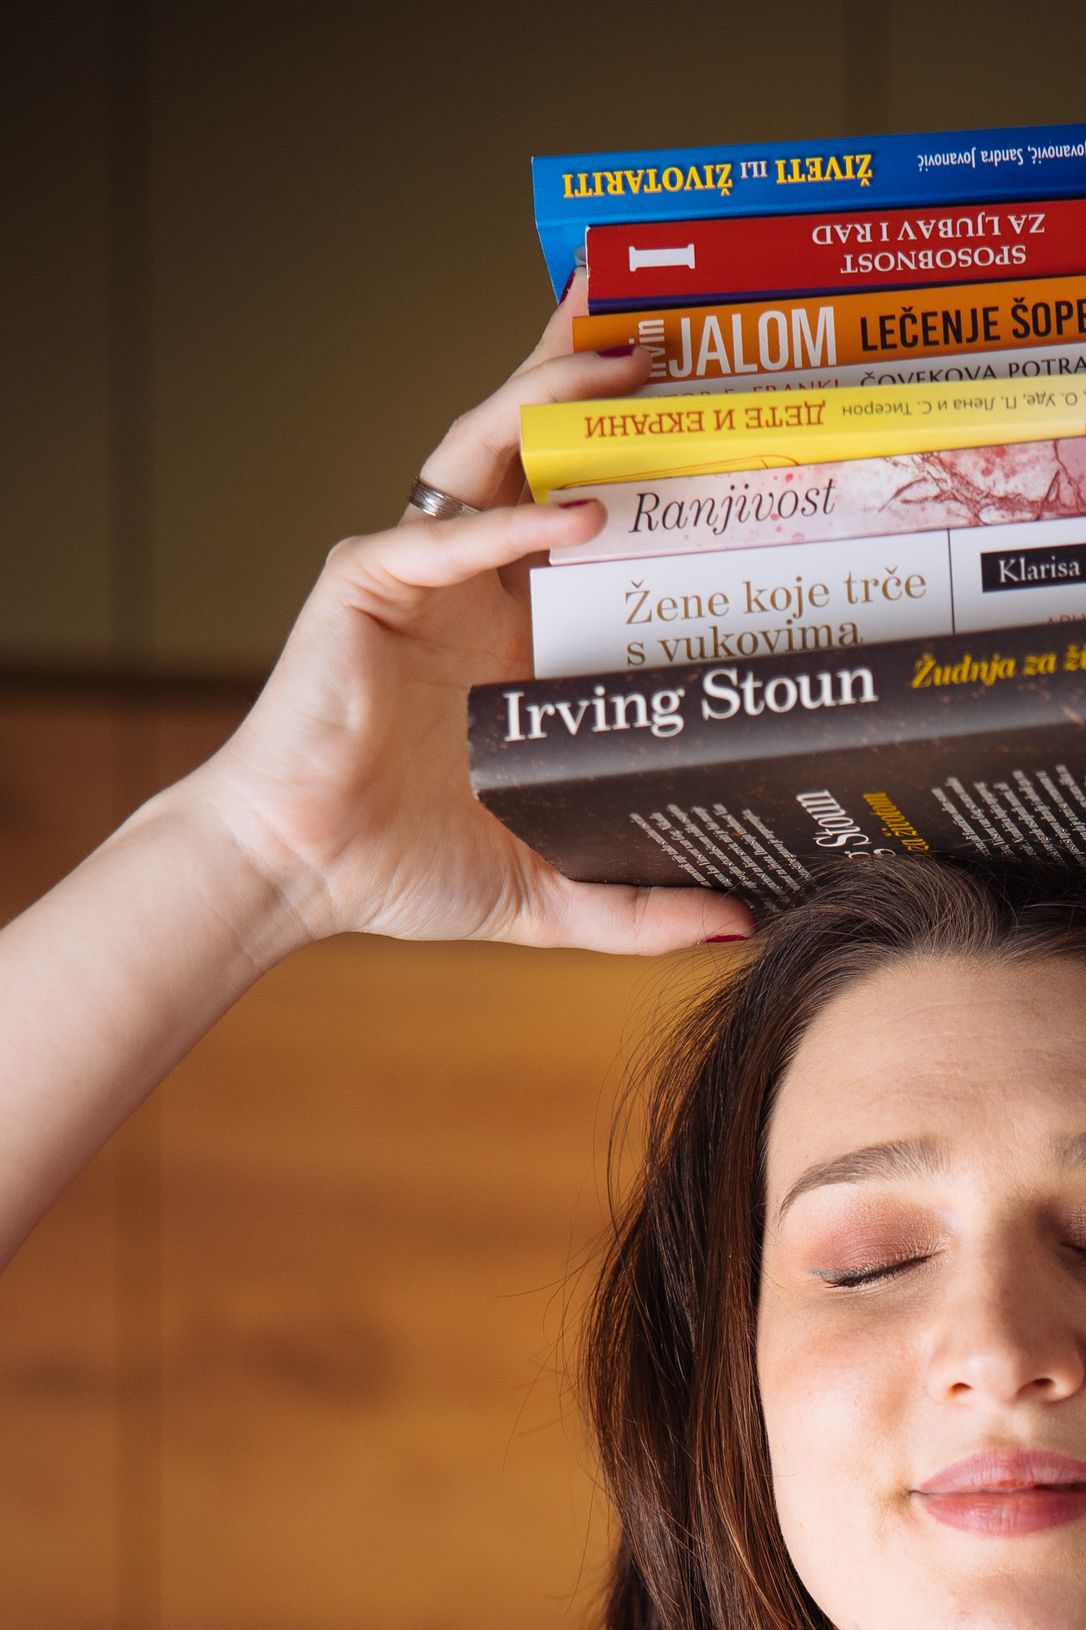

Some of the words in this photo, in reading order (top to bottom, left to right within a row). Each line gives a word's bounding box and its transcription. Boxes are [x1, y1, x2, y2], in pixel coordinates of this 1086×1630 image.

[741, 160, 767, 179] ILI
[776, 154, 872, 187] ŽIVETI
[918, 147, 976, 172] Jovanović
[981, 148, 1024, 167] Sandra
[562, 163, 732, 198] ŽIVOTARITI
[811, 223, 873, 245] RAD
[880, 222, 890, 242] I
[897, 212, 1001, 240] LJUBAV
[1008, 213, 1046, 235] ZA
[840, 245, 1026, 274] SPOSOBNOST
[859, 304, 1000, 352] LEČENJE
[669, 306, 838, 379] JALOM
[842, 401, 912, 416] Тисерон
[917, 401, 932, 413] С.
[937, 400, 948, 411] и
[953, 397, 996, 411] Лена
[1000, 397, 1017, 410] П.
[1022, 392, 1056, 408] Уде,
[1061, 392, 1078, 407] О.
[585, 411, 705, 439] ЕКРАНИ
[714, 409, 735, 431] И
[746, 399, 826, 429] ДЕТЕ
[627, 478, 837, 536] Ranjivost
[997, 556, 1081, 583] Klarisa
[624, 579, 730, 626] Žene
[743, 579, 830, 620] koje
[844, 565, 927, 605] trče
[627, 640, 647, 667] s
[659, 618, 864, 664] vukovima
[911, 652, 1015, 690] Žudnja
[1024, 654, 1056, 676] za
[503, 685, 685, 742] Irving
[701, 667, 879, 721] Stoun
[796, 789, 872, 848] Stoun
